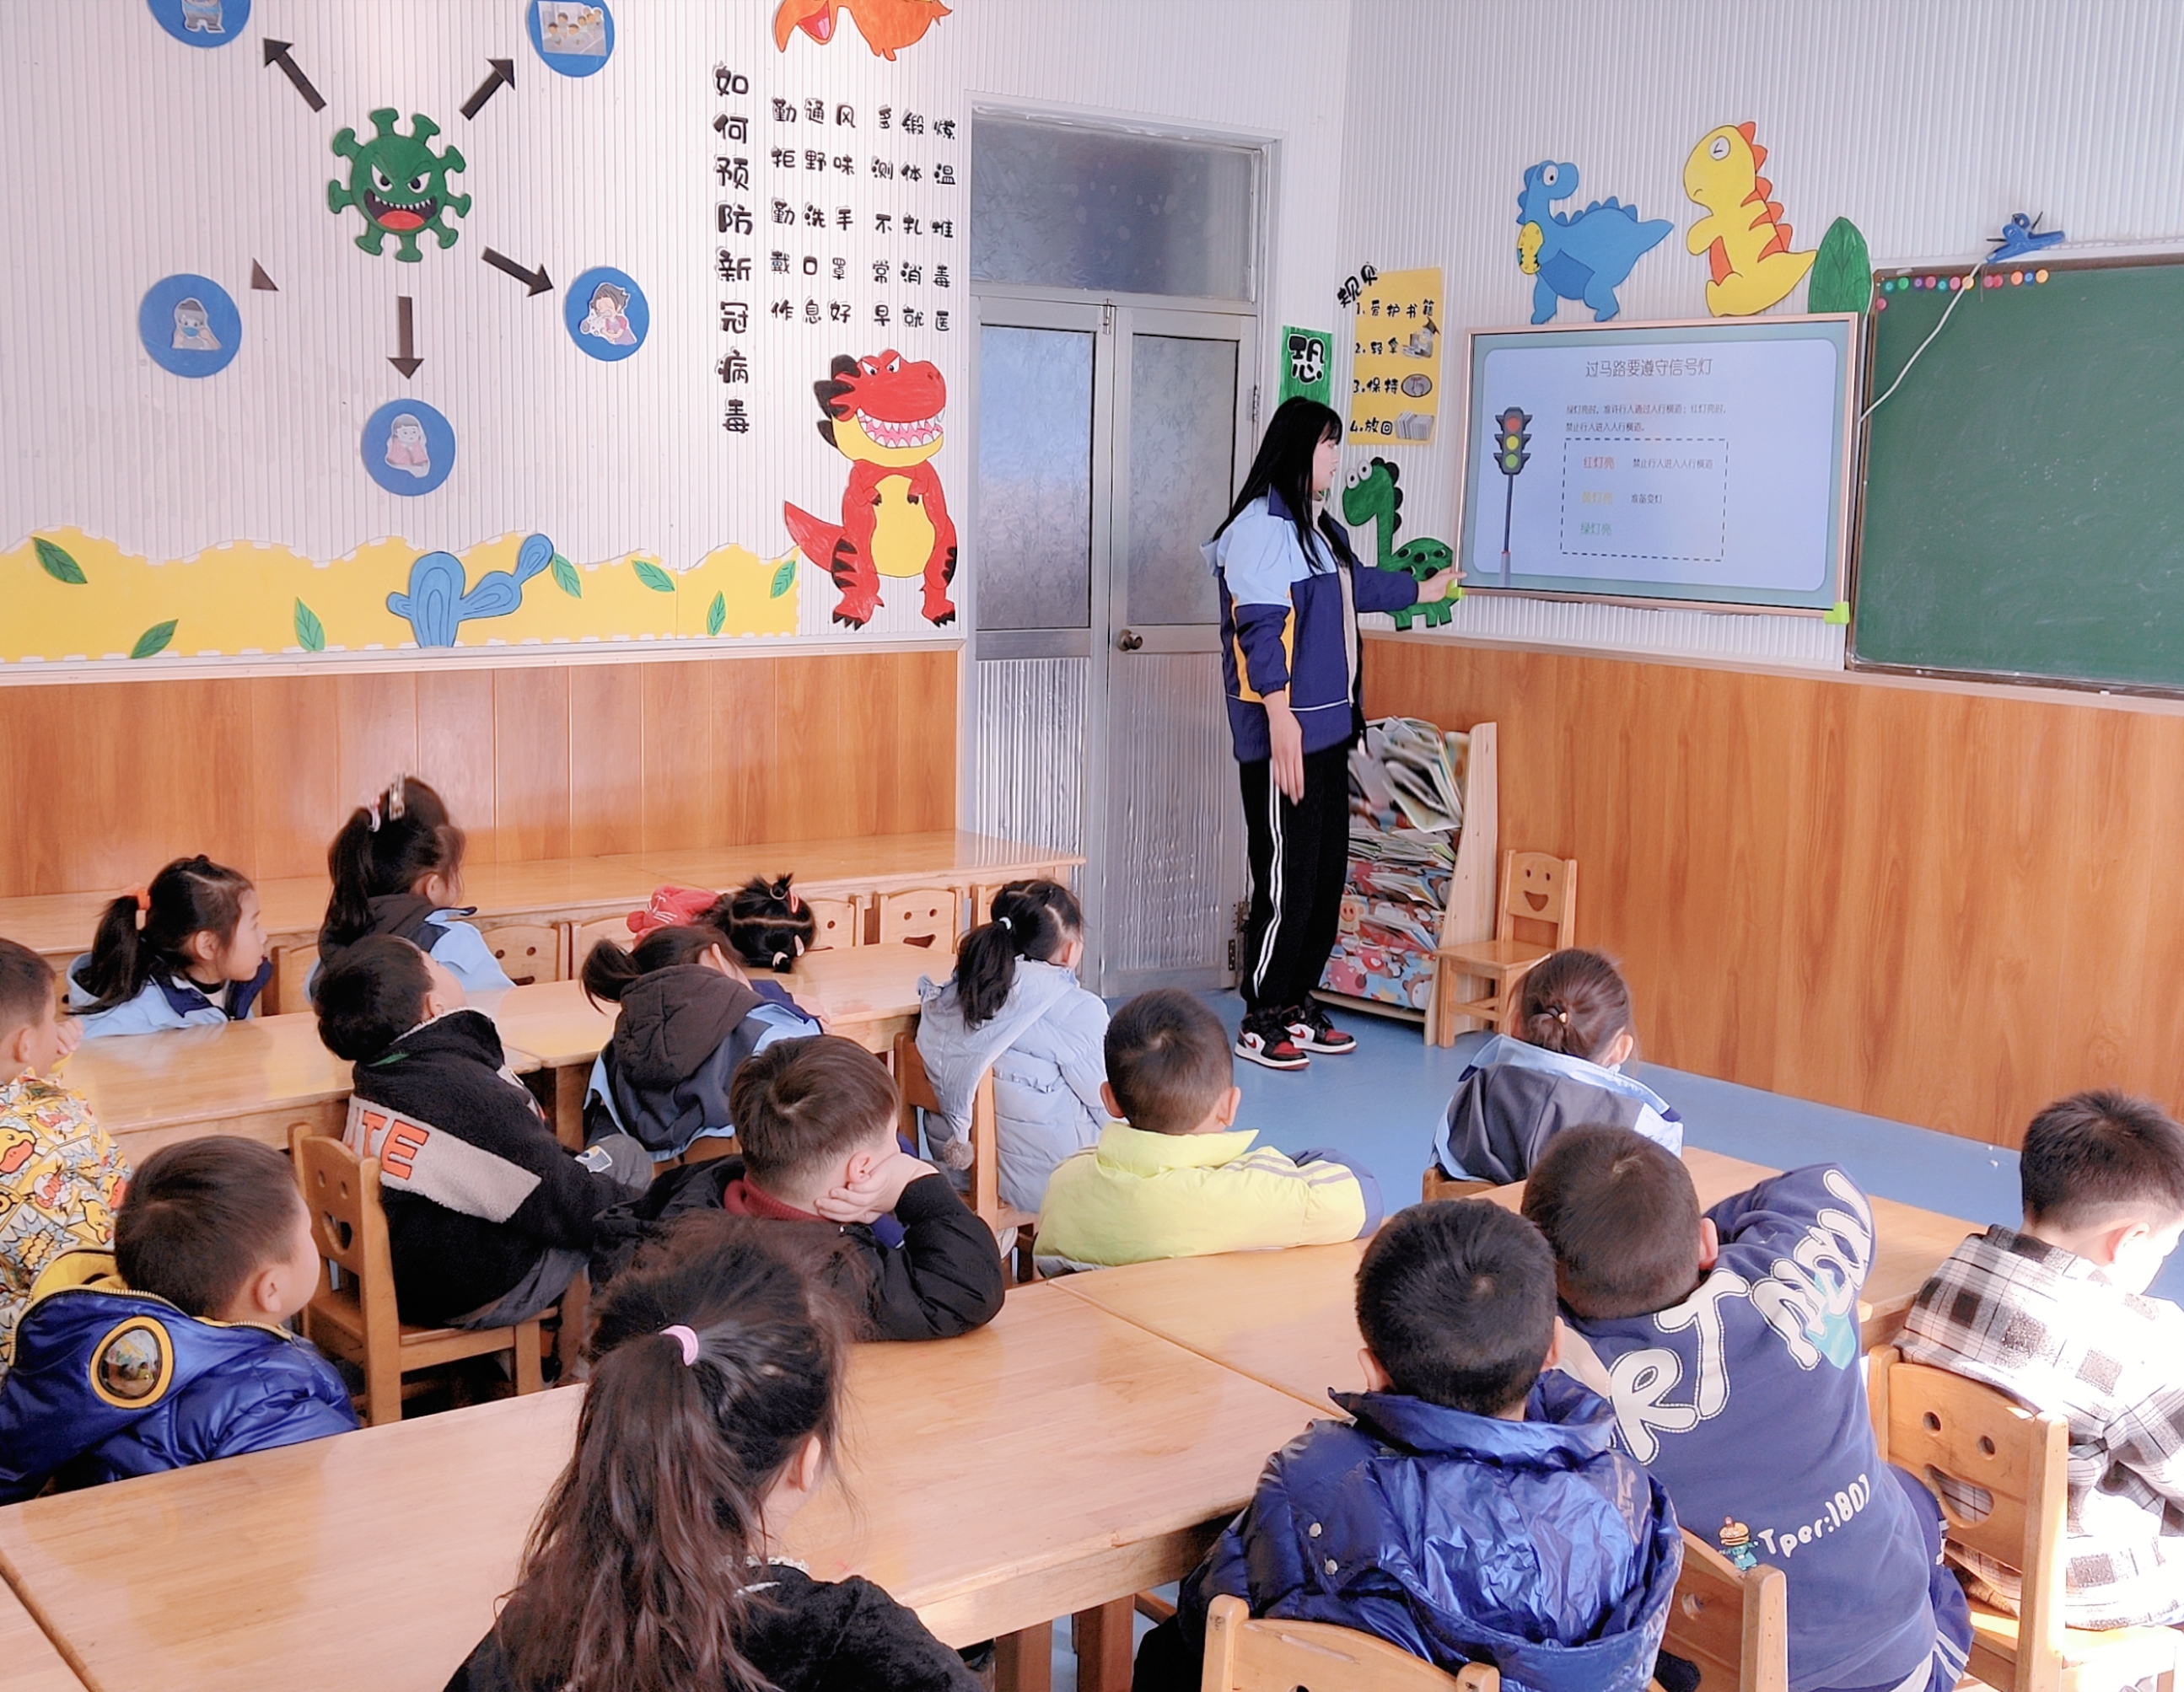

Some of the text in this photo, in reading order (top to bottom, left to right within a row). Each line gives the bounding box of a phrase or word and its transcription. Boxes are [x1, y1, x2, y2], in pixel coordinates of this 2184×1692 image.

[773, 99, 956, 140] 勤通风 多锻炼
[772, 148, 956, 185] 拒野味 测体温
[773, 201, 954, 238] 勤洗手 不扎堆
[714, 66, 752, 434] 如何预防新冠病毒
[771, 251, 950, 288] 戴口罩 常消毒
[771, 299, 949, 331] 作息好 早就医
[1585, 357, 1713, 378] 过马路要遵守信号灯
[1583, 456, 1713, 470] 红灯亮 禁止行人进入人行横道
[1581, 491, 1614, 505] 黄灯亮
[1580, 522, 1612, 536] 绿灯亮
[347, 1106, 429, 1180] TE
